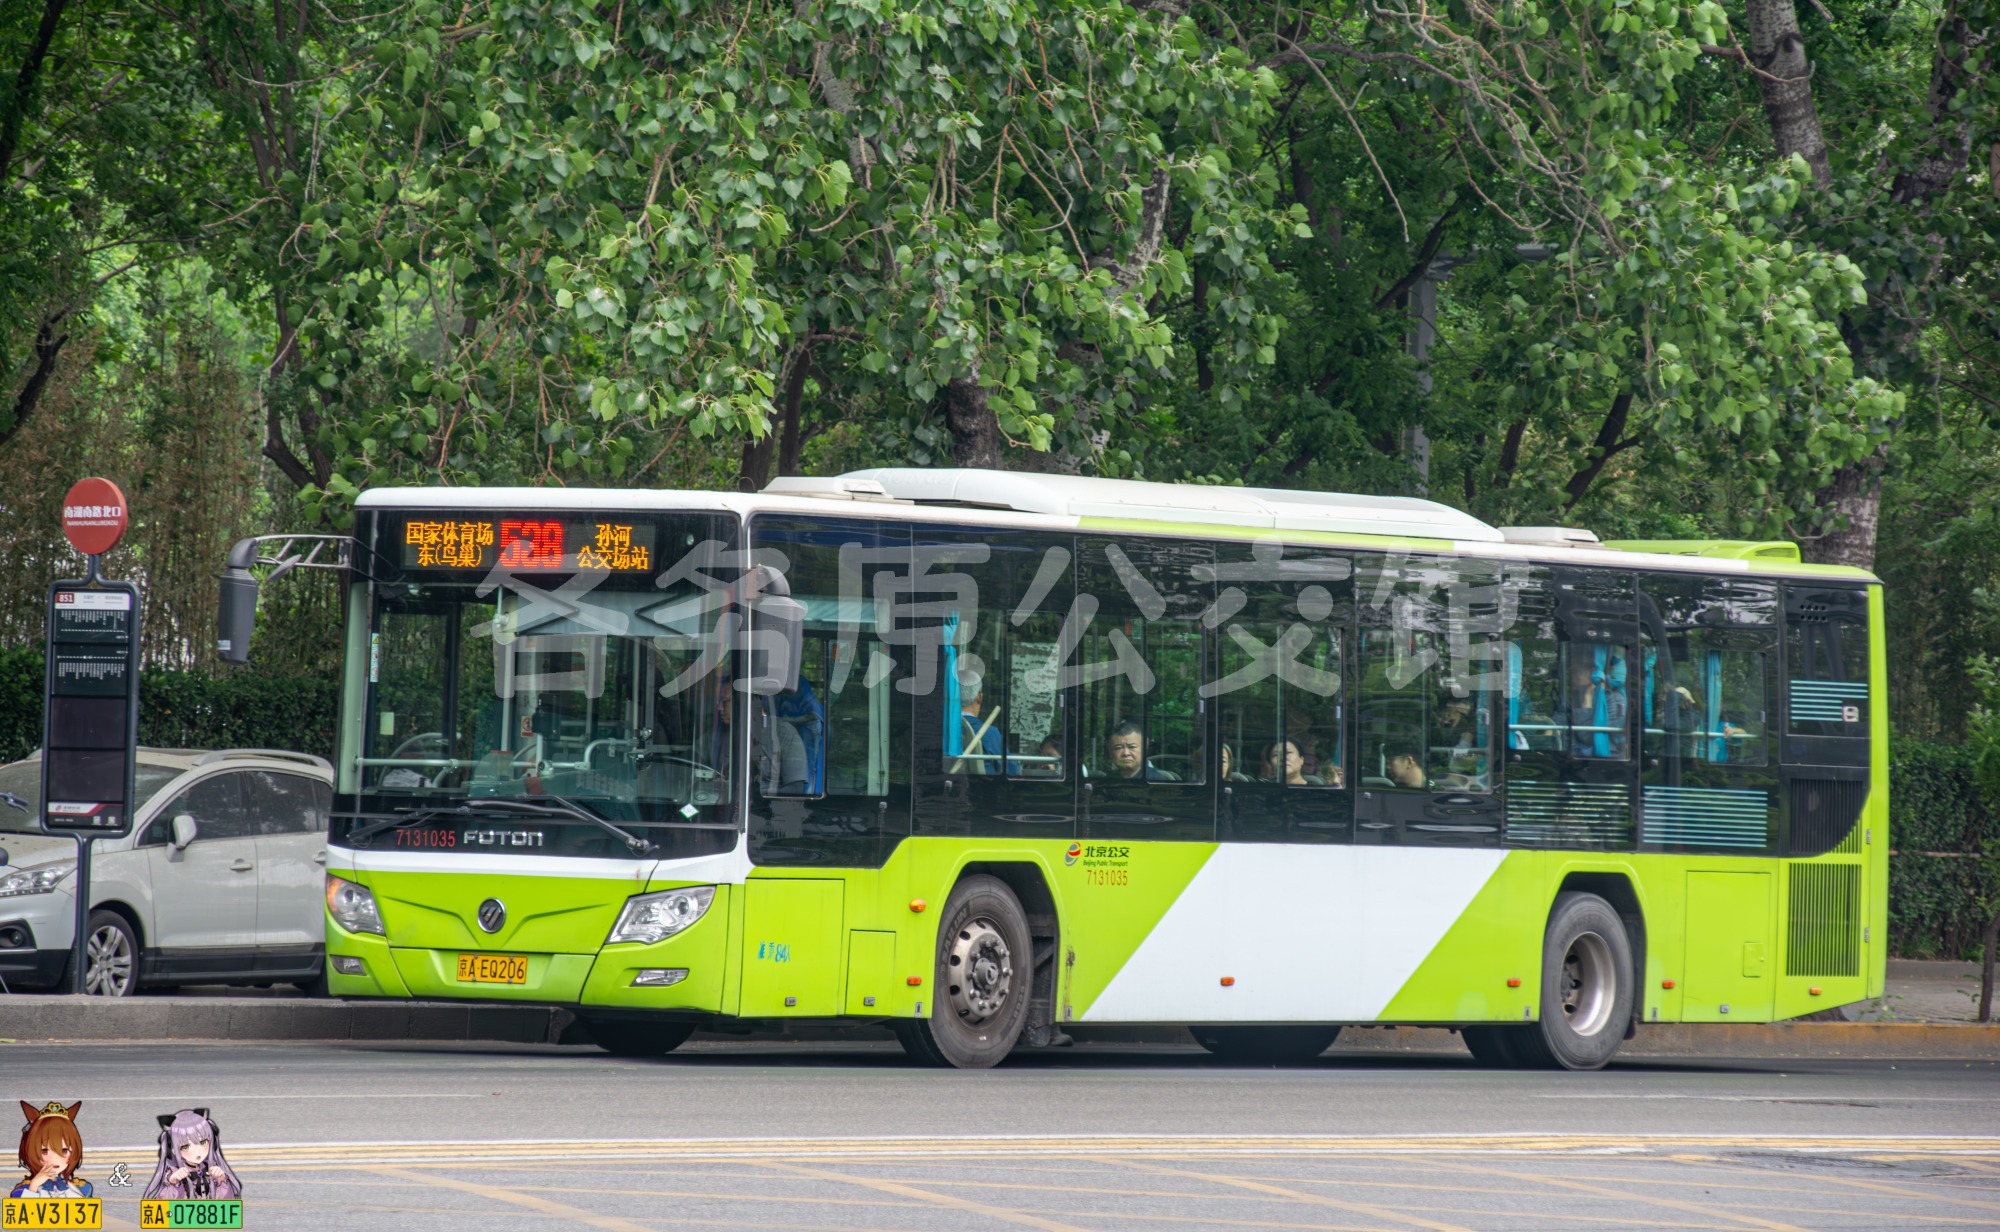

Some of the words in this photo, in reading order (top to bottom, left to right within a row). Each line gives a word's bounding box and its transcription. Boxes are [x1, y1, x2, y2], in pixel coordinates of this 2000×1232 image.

[64, 506, 121, 518] 南湖南路北口
[406, 521, 494, 546] 国家体育场
[594, 523, 633, 547] 孙河
[499, 520, 563, 568] 538
[417, 543, 483, 568] 东(鸟巢)
[576, 545, 650, 570] 公交场站
[59, 594, 74, 603] 851
[396, 829, 456, 848] 7131035
[463, 830, 543, 847] FOTON
[1084, 845, 1130, 858] 北京公交
[1087, 869, 1128, 886] 7131035
